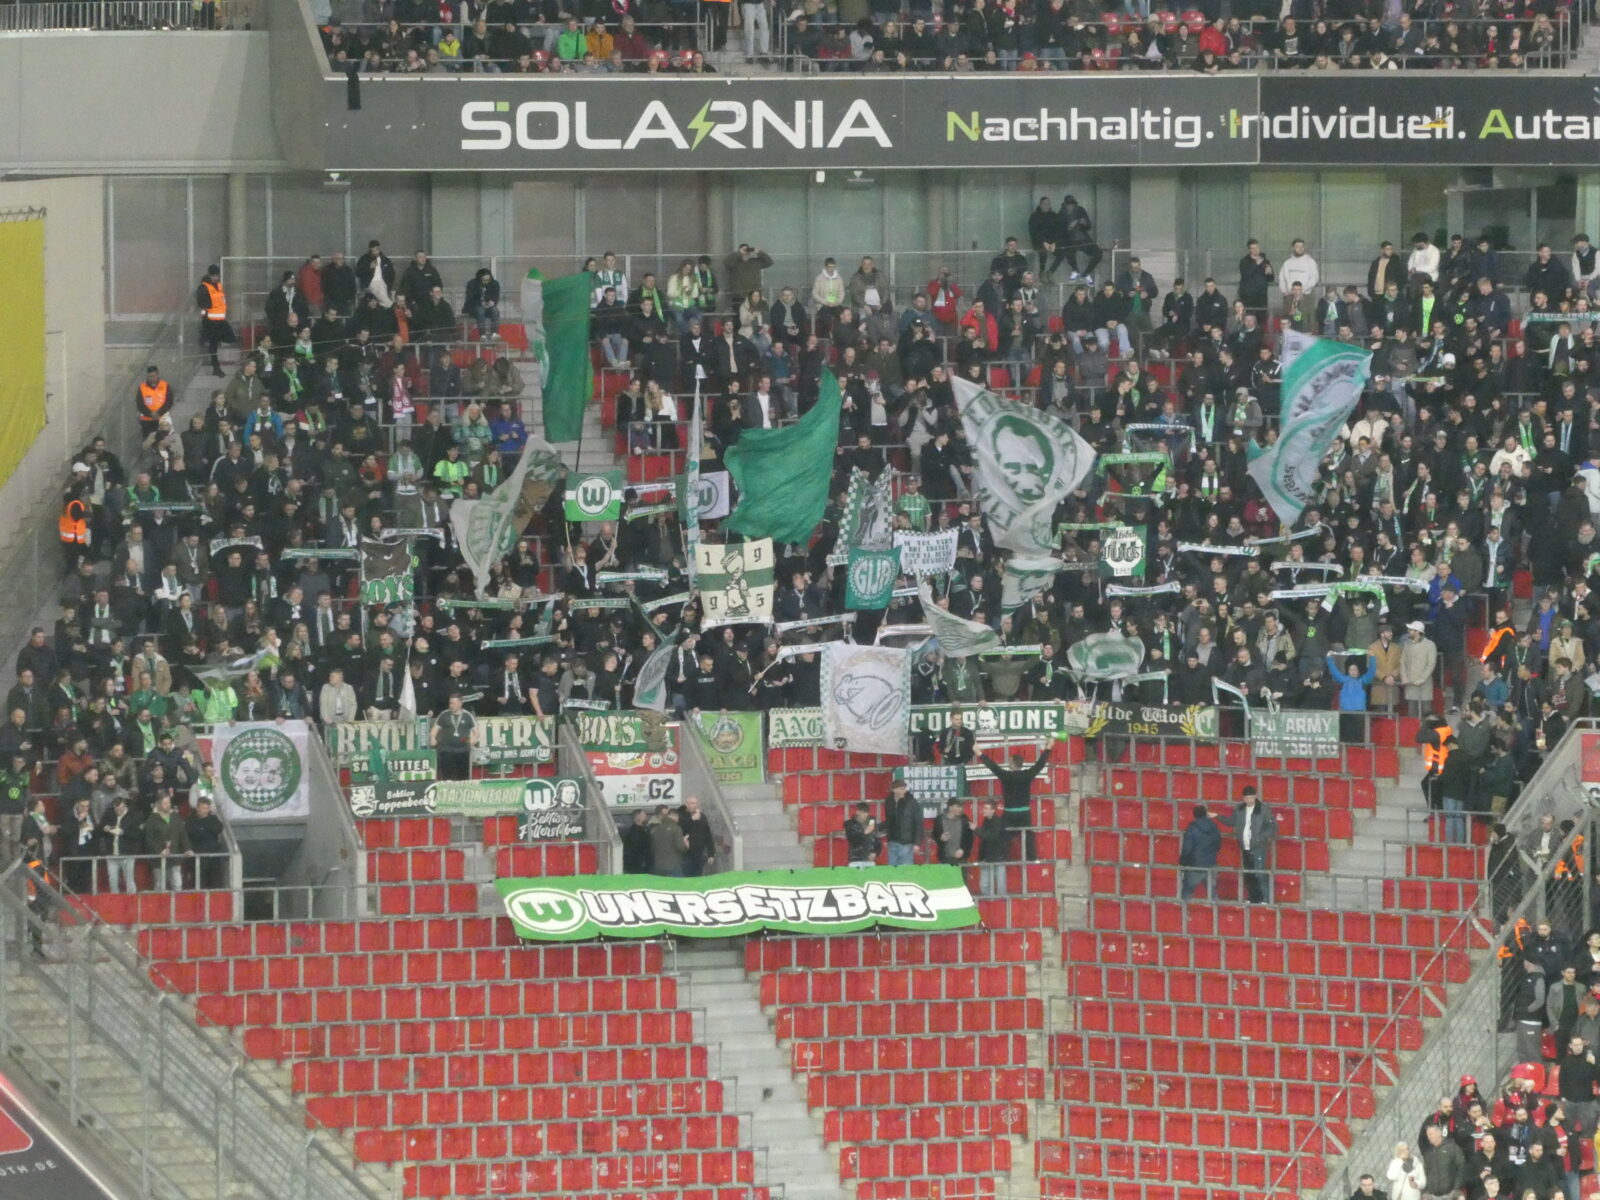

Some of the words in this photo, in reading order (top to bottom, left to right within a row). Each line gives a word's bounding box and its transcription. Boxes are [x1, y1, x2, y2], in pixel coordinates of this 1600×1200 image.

[461, 99, 893, 150] SOLARNIA
[947, 107, 1214, 147] Nachhaltig.
[1229, 106, 1467, 139] Individuell.
[650, 778, 675, 799] G2
[581, 881, 935, 926] UNERSETZBAR
